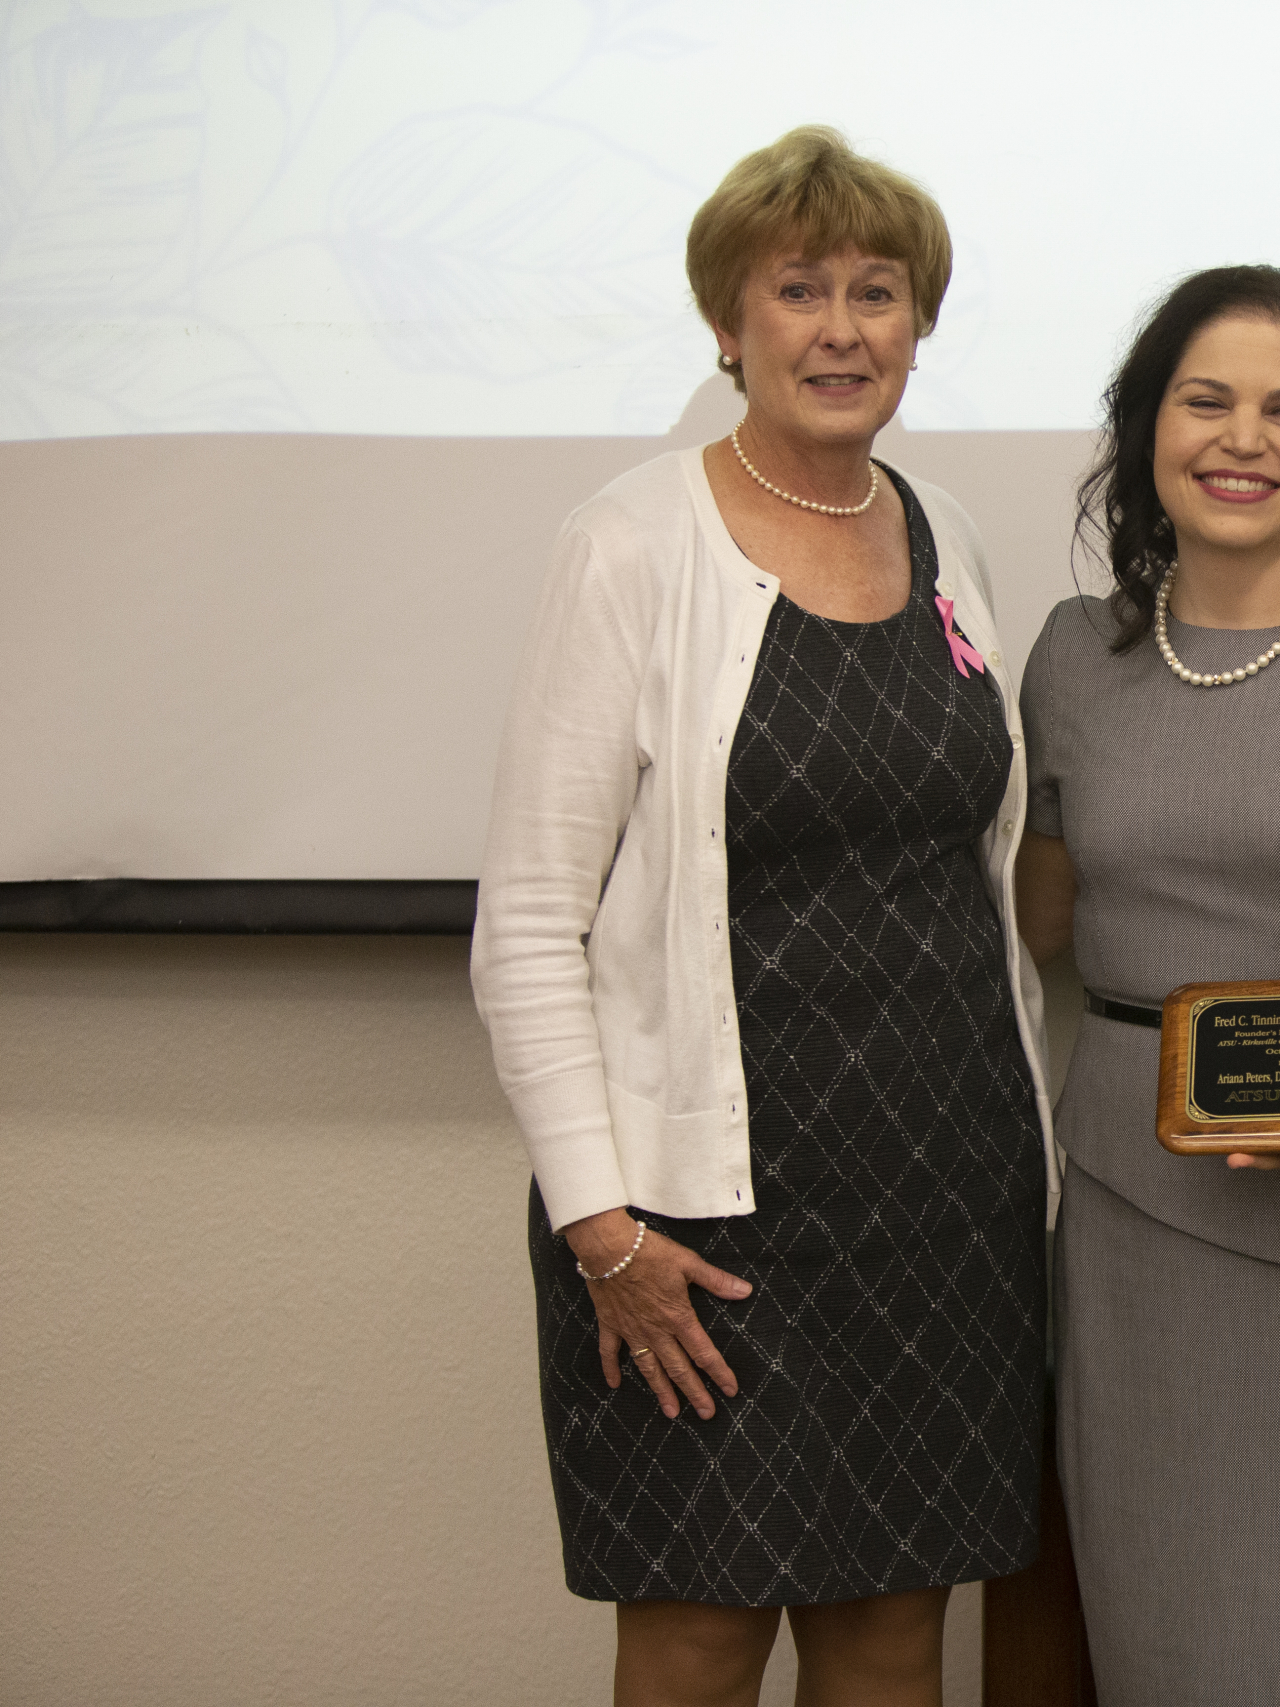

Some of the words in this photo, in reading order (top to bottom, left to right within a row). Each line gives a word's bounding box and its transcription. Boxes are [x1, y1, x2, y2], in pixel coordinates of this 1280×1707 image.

[1214, 1015, 1236, 1027] Fred
[1238, 1015, 1249, 1026] C.
[1242, 1038, 1277, 1046] Kirksville
[1217, 1074, 1244, 1084] Ariana
[1246, 1072, 1273, 1084] Peters,
[1224, 1090, 1280, 1102] ATSU
